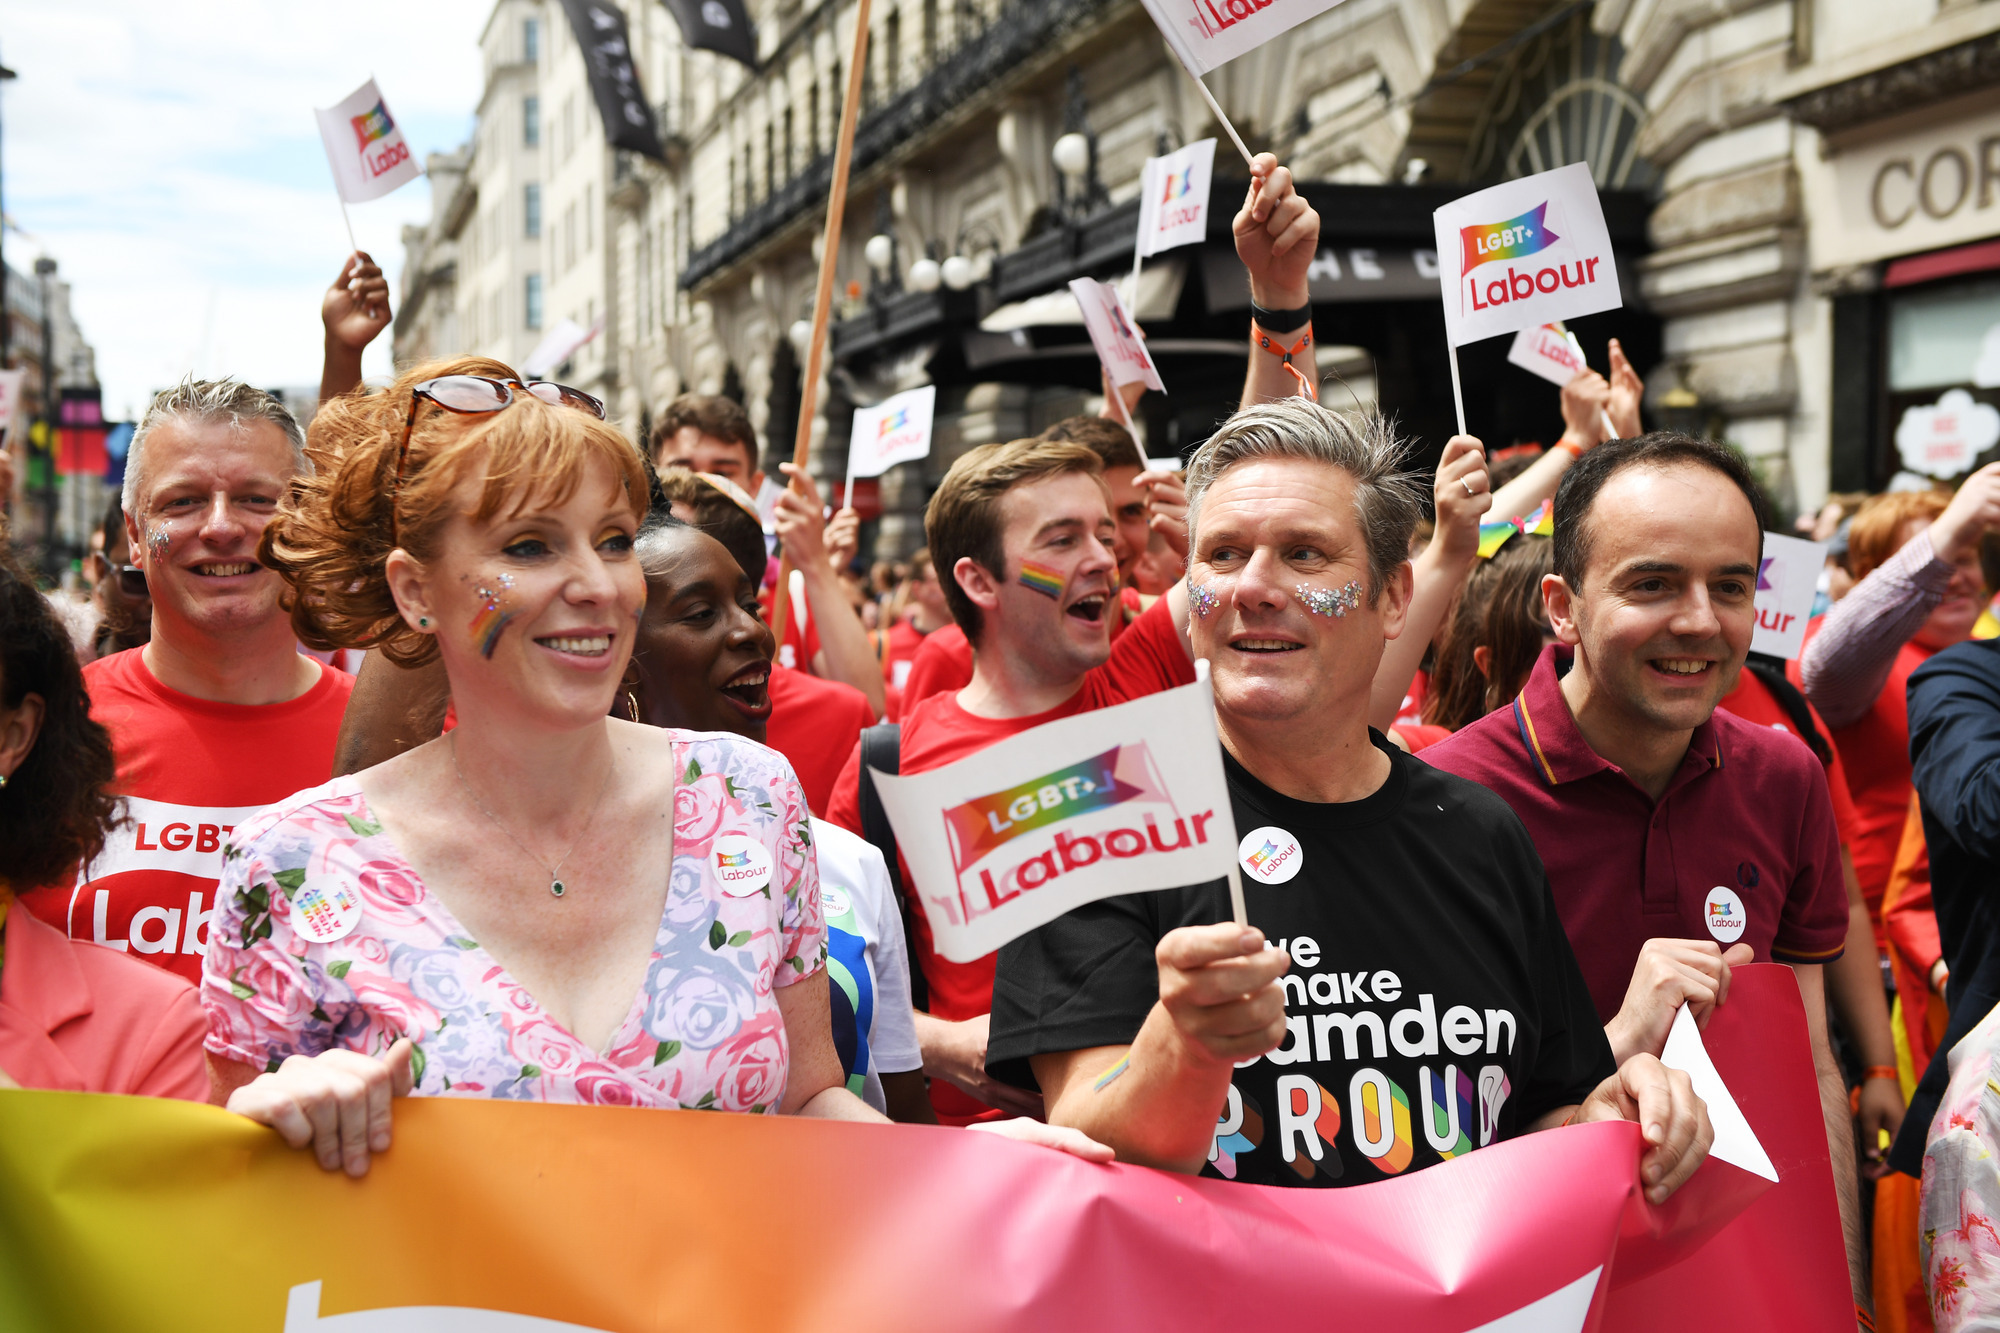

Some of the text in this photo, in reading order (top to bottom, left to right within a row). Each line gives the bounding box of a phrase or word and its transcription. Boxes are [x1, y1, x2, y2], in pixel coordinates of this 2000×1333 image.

[1476, 225, 1534, 255] LGBT+
[1470, 256, 1600, 311] Labour
[987, 775, 1097, 834] LGBT+
[721, 866, 767, 881] Labour
[979, 809, 1214, 910] Labour
[1259, 843, 1297, 877] Labour
[297, 899, 323, 937] NEVER
[304, 892, 334, 935] KISSED
[311, 889, 342, 928] A TORY
[1711, 917, 1742, 928] Labour
[1233, 993, 1517, 1068] amden
